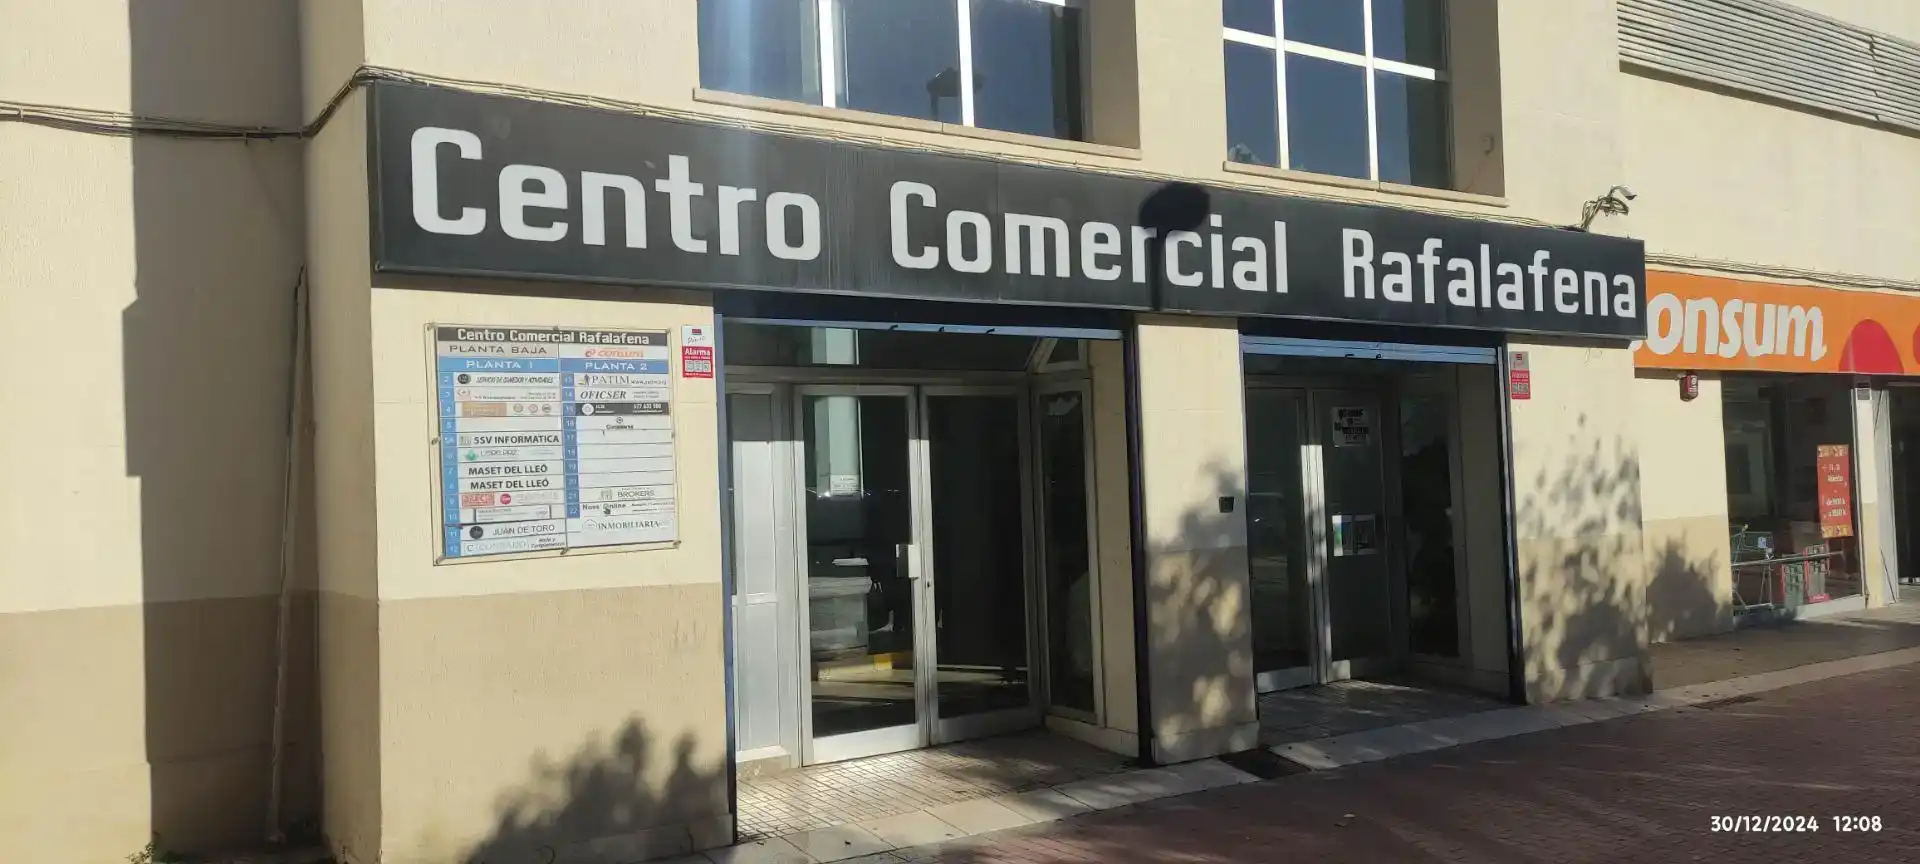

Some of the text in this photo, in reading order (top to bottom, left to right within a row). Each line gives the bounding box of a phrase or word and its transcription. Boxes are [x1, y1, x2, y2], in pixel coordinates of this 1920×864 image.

[411, 126, 1636, 318] Centro Comercial Rafalafena
[1629, 292, 1828, 362] onsum
[457, 328, 650, 345] Centro Comercial Rafalafena
[449, 345, 547, 354] PLANTA BAJA
[685, 347, 711, 357] Alarma
[466, 360, 533, 369] PLANTA 1
[585, 362, 648, 371] PLANTA 2
[592, 375, 631, 385] PATIM
[580, 391, 627, 400] OFICSER
[495, 435, 560, 444] INFORMATICA
[468, 464, 548, 476] MASET DEL LLEÓ
[470, 478, 549, 490] MASET DEL LLEÓ
[493, 524, 555, 536] JUAN DE TORO
